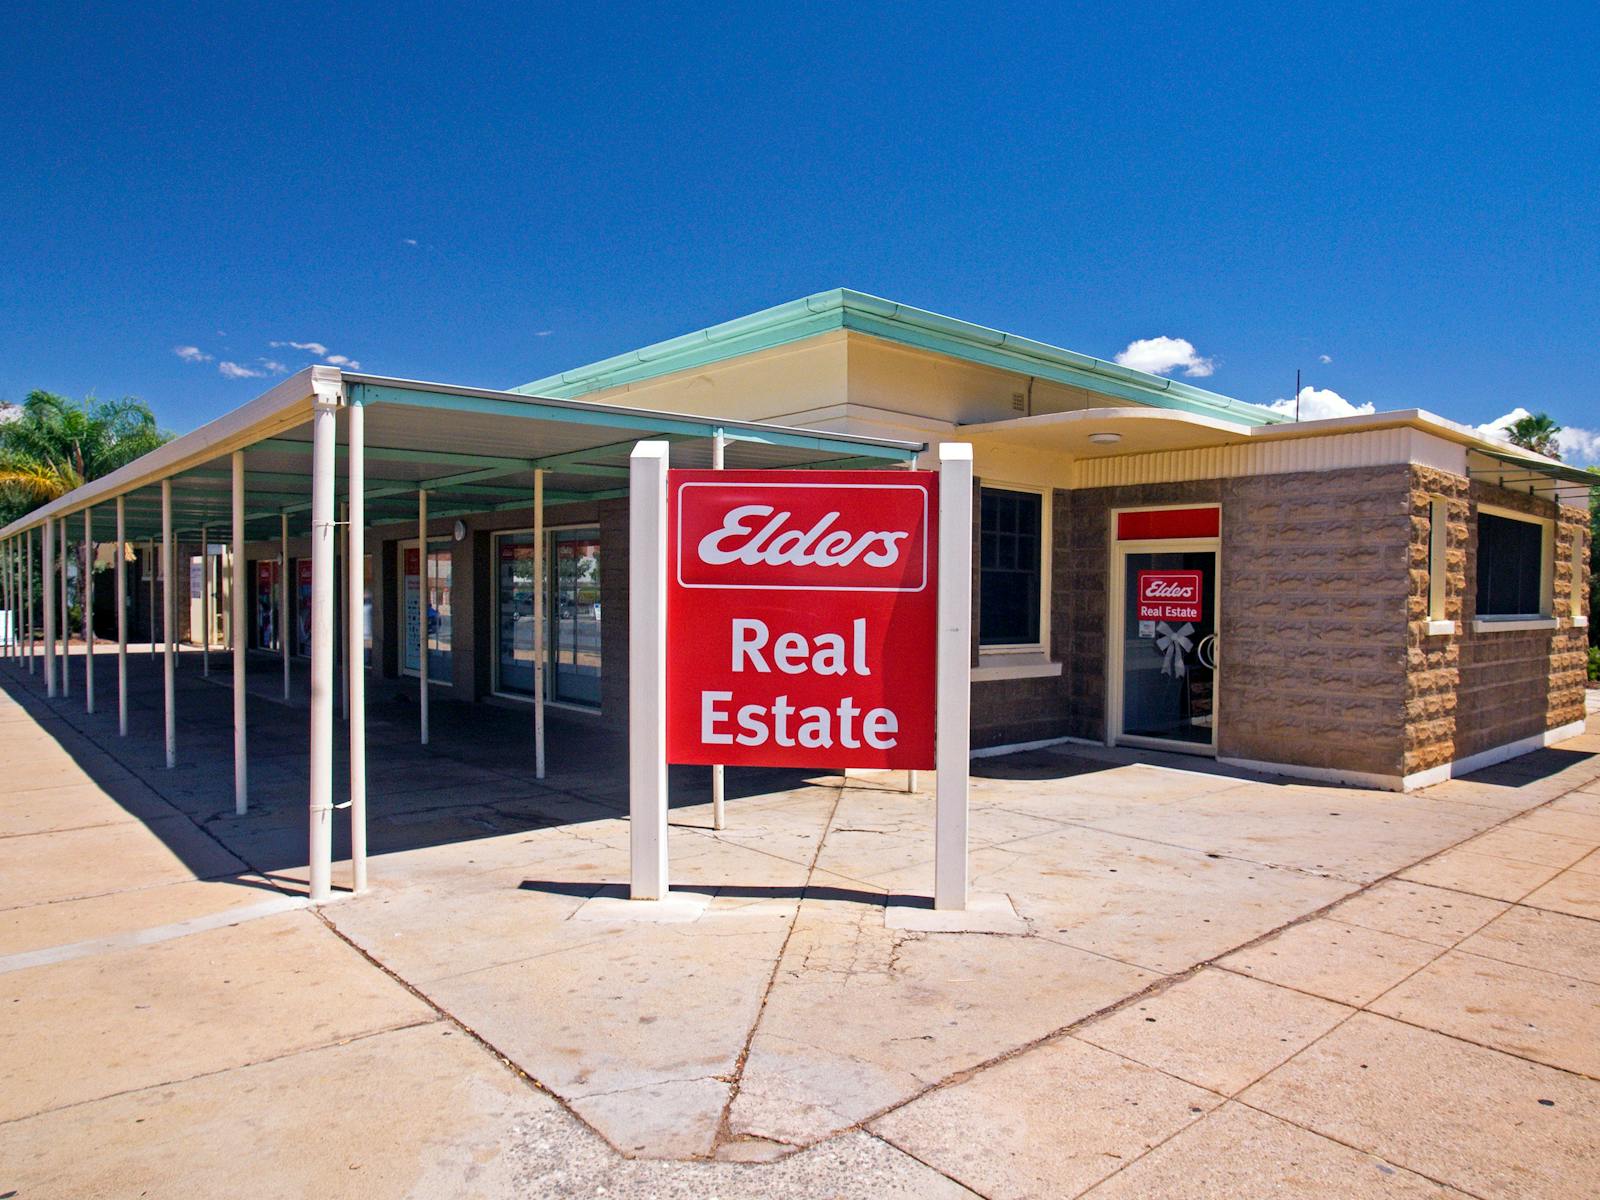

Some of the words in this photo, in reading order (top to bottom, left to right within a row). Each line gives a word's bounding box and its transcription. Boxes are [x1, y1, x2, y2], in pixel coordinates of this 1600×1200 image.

[698, 505, 909, 567] Elders
[1141, 606, 1162, 617] Real
[1165, 606, 1198, 618] Estate
[1145, 580, 1195, 597] Elders
[732, 617, 871, 676] Real
[701, 691, 899, 749] Estate
